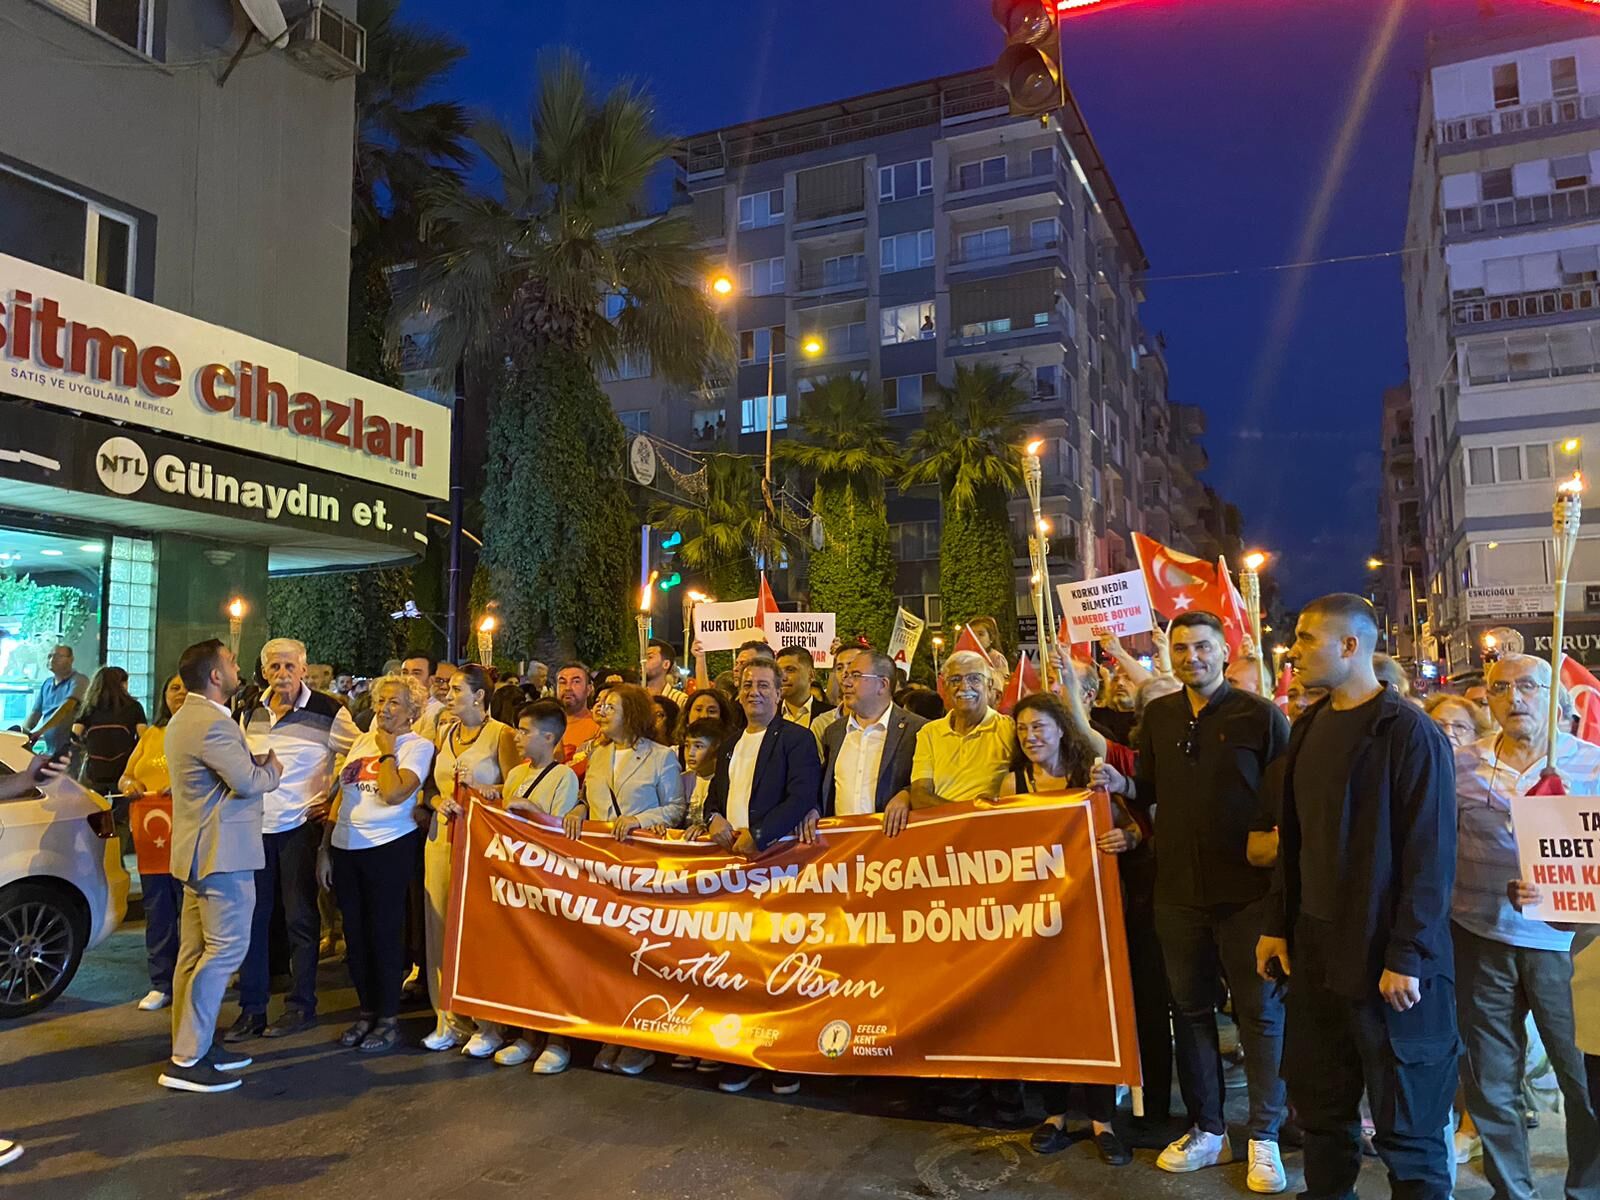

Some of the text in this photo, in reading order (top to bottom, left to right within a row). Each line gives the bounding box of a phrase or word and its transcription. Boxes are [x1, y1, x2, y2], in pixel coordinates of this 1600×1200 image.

[0, 289, 424, 468] itme cihazları
[11, 367, 47, 386] SATIŞ
[51, 377, 65, 389] VE
[69, 382, 130, 405] UYGULAMA
[100, 453, 146, 476] NTL
[154, 454, 340, 523] Günaydın
[1071, 579, 1128, 600] KORKU NEDİR
[1081, 595, 1123, 611] BİLMEYİZ!
[1072, 611, 1109, 625] NAMERDE
[1111, 605, 1142, 620] BOYUN
[775, 618, 824, 634] BAĞIMSIZLIK
[781, 634, 817, 648] EFELER'İN
[1539, 838, 1594, 858] ELBET
[484, 833, 1065, 900] AYDIN'IMIZIN DÜŞMAN İŞGALİNDEN
[1533, 864, 1576, 884] HEM
[489, 875, 1063, 944] KURTULUŞUNUN 103. YIL DÖNÜMÜ
[1553, 891, 1596, 912] HEM
[630, 937, 884, 998] Kutlu Olsun
[853, 1034, 877, 1045] KENT
[857, 1024, 887, 1035] EFELER
[853, 1045, 893, 1056] KONSEYİ
